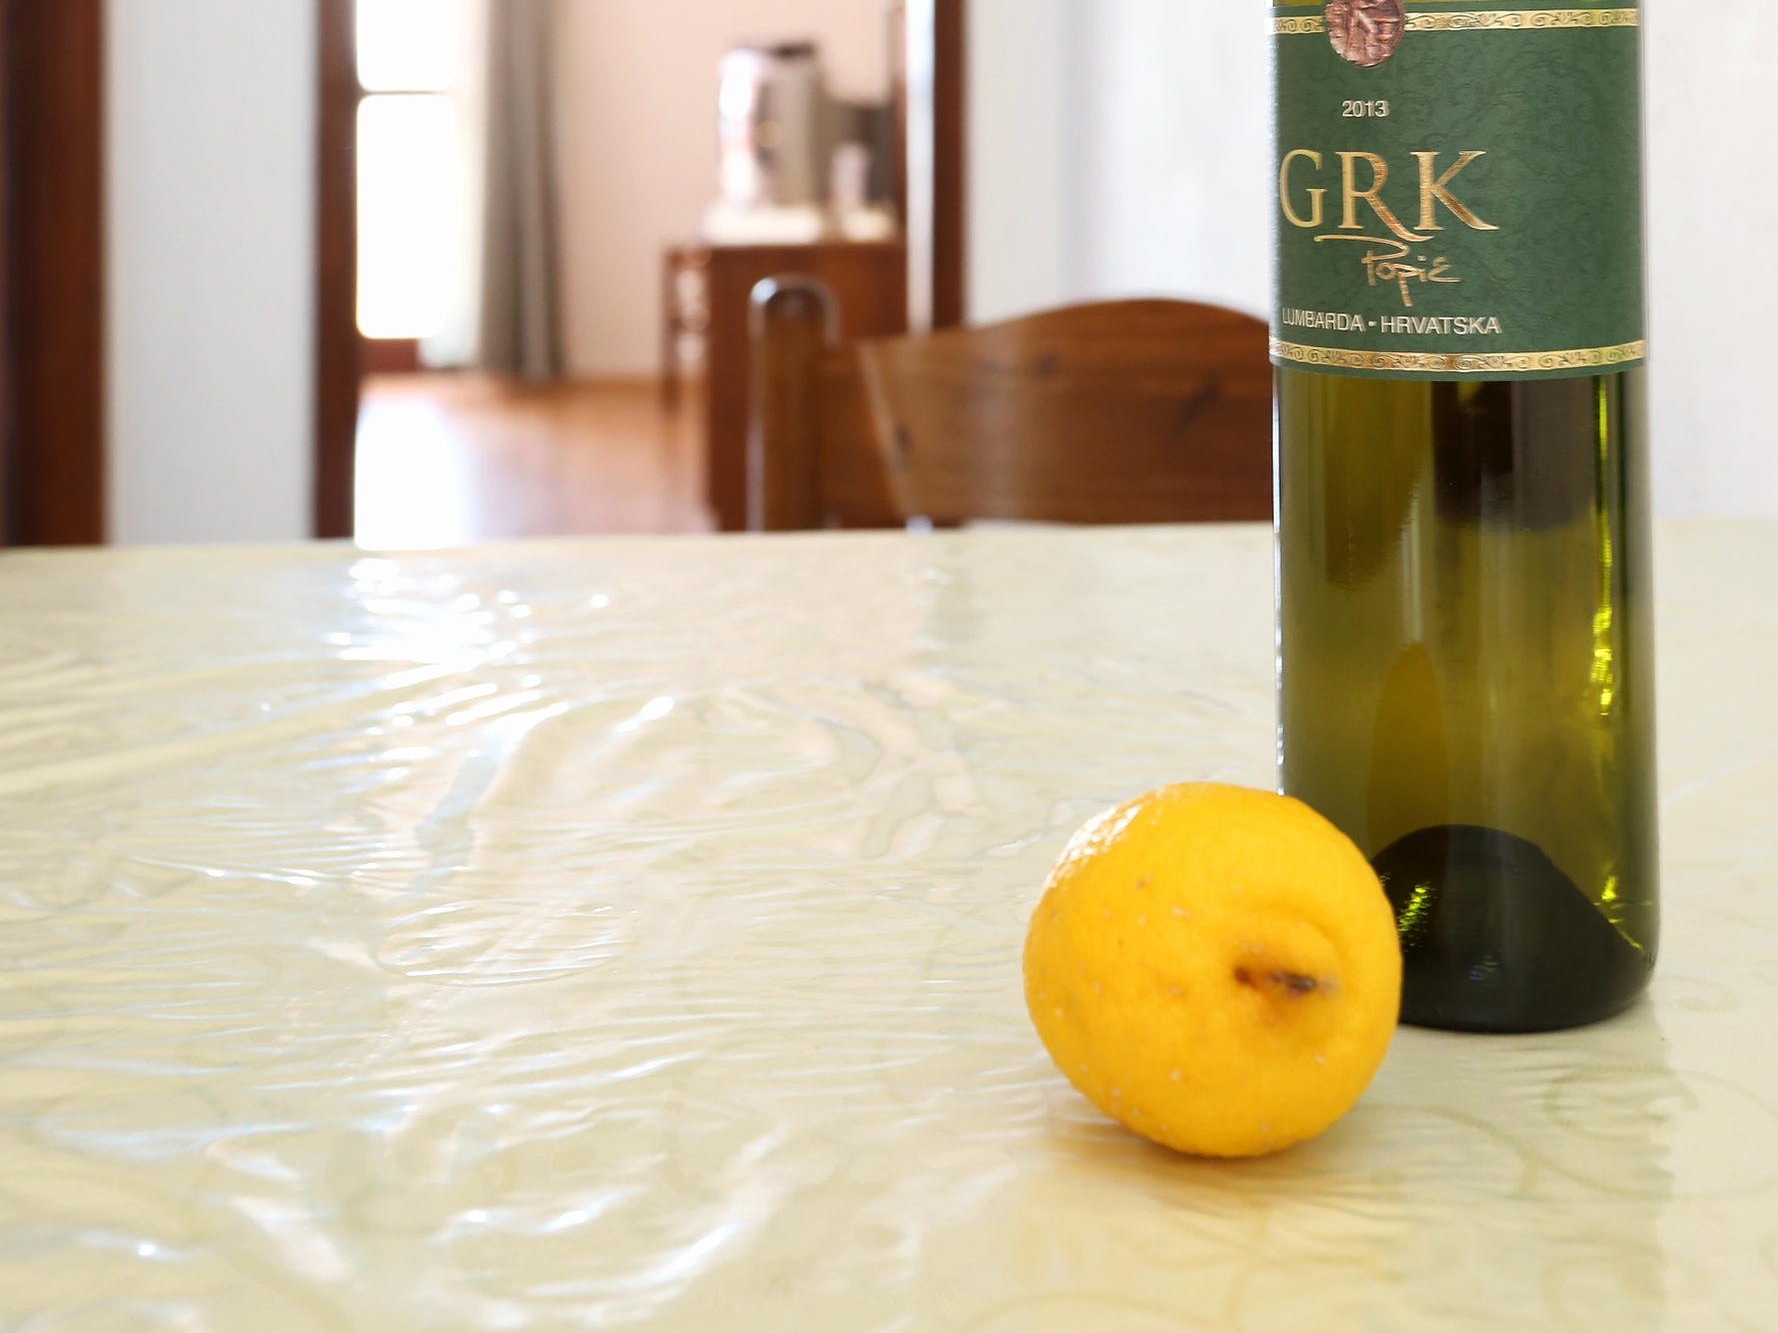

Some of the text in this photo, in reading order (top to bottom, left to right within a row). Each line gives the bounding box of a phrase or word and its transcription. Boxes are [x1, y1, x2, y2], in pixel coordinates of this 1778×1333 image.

[1342, 100, 1389, 117] 2013
[1280, 149, 1499, 242] GRK
[1282, 307, 1502, 334] LUMBARDA HRVATSKA
